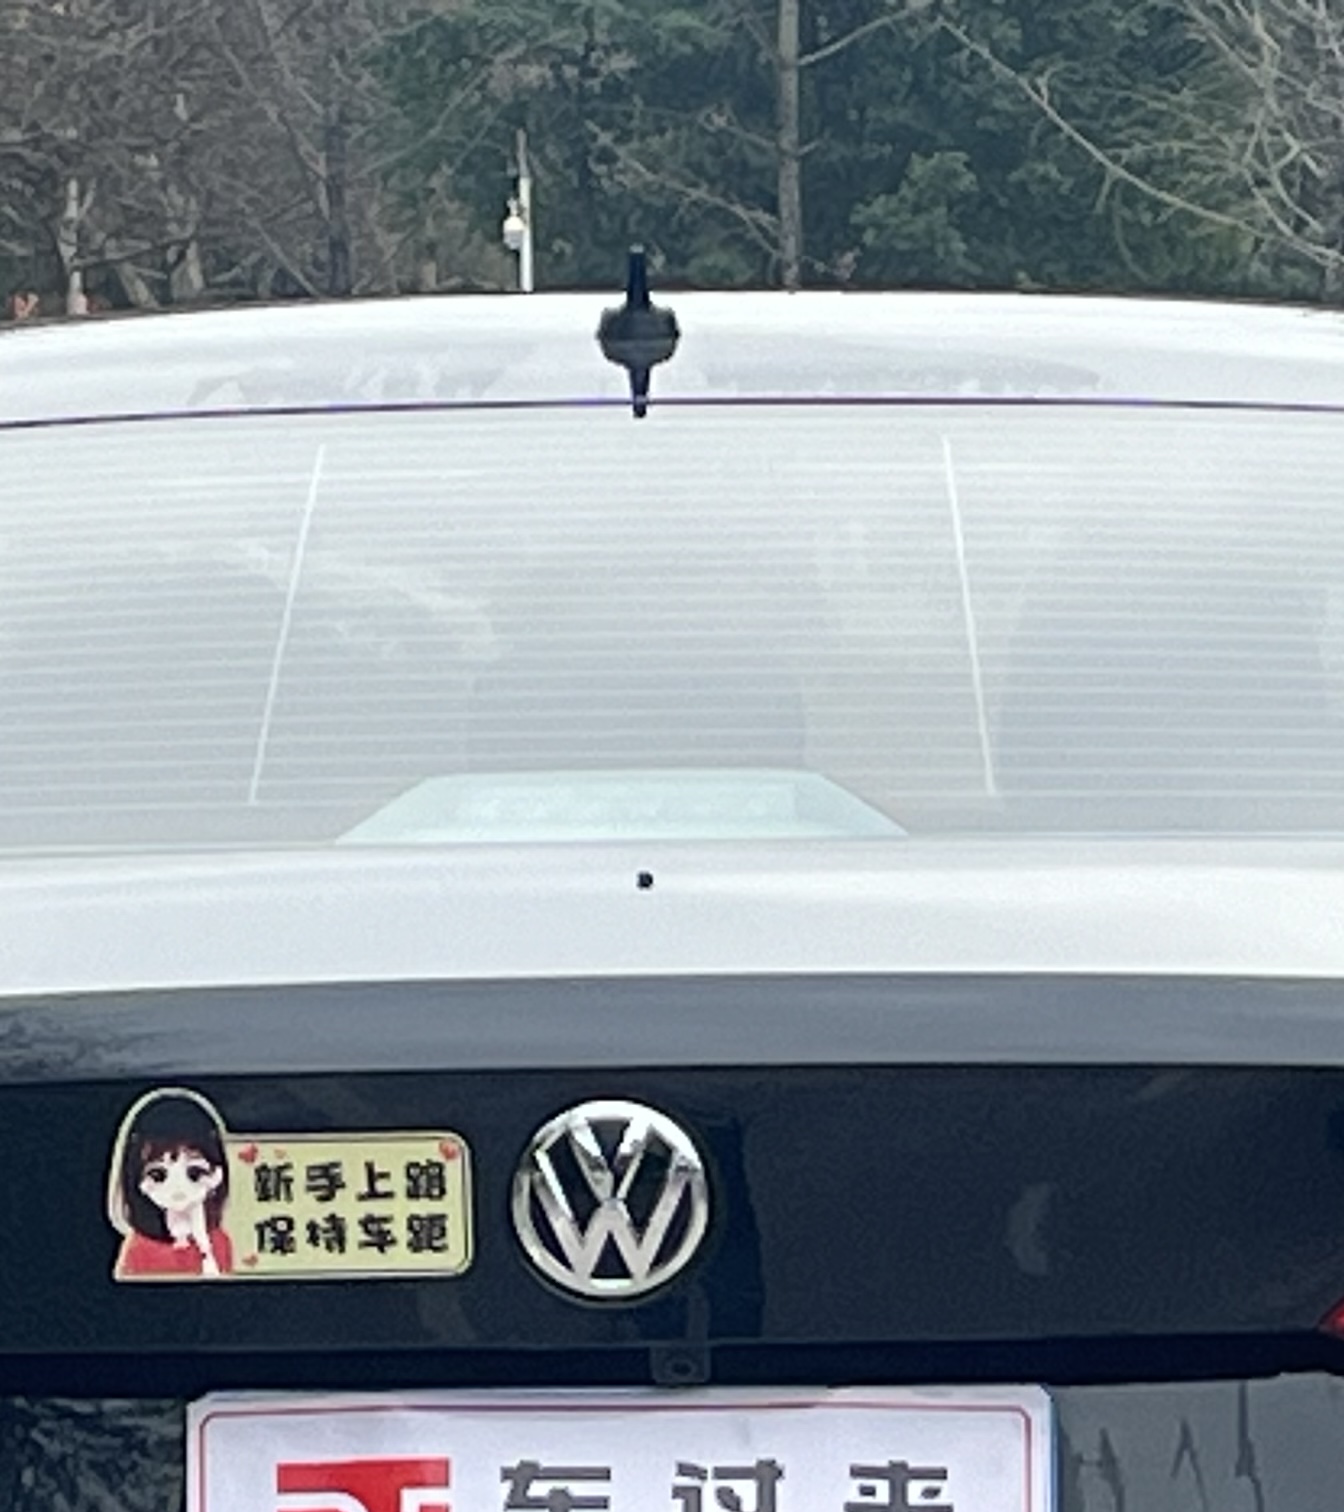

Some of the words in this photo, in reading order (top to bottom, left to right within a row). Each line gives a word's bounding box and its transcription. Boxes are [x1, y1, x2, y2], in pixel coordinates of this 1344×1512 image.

[254, 1159, 447, 1203] 新手上路
[254, 1213, 449, 1255] 保持车距
